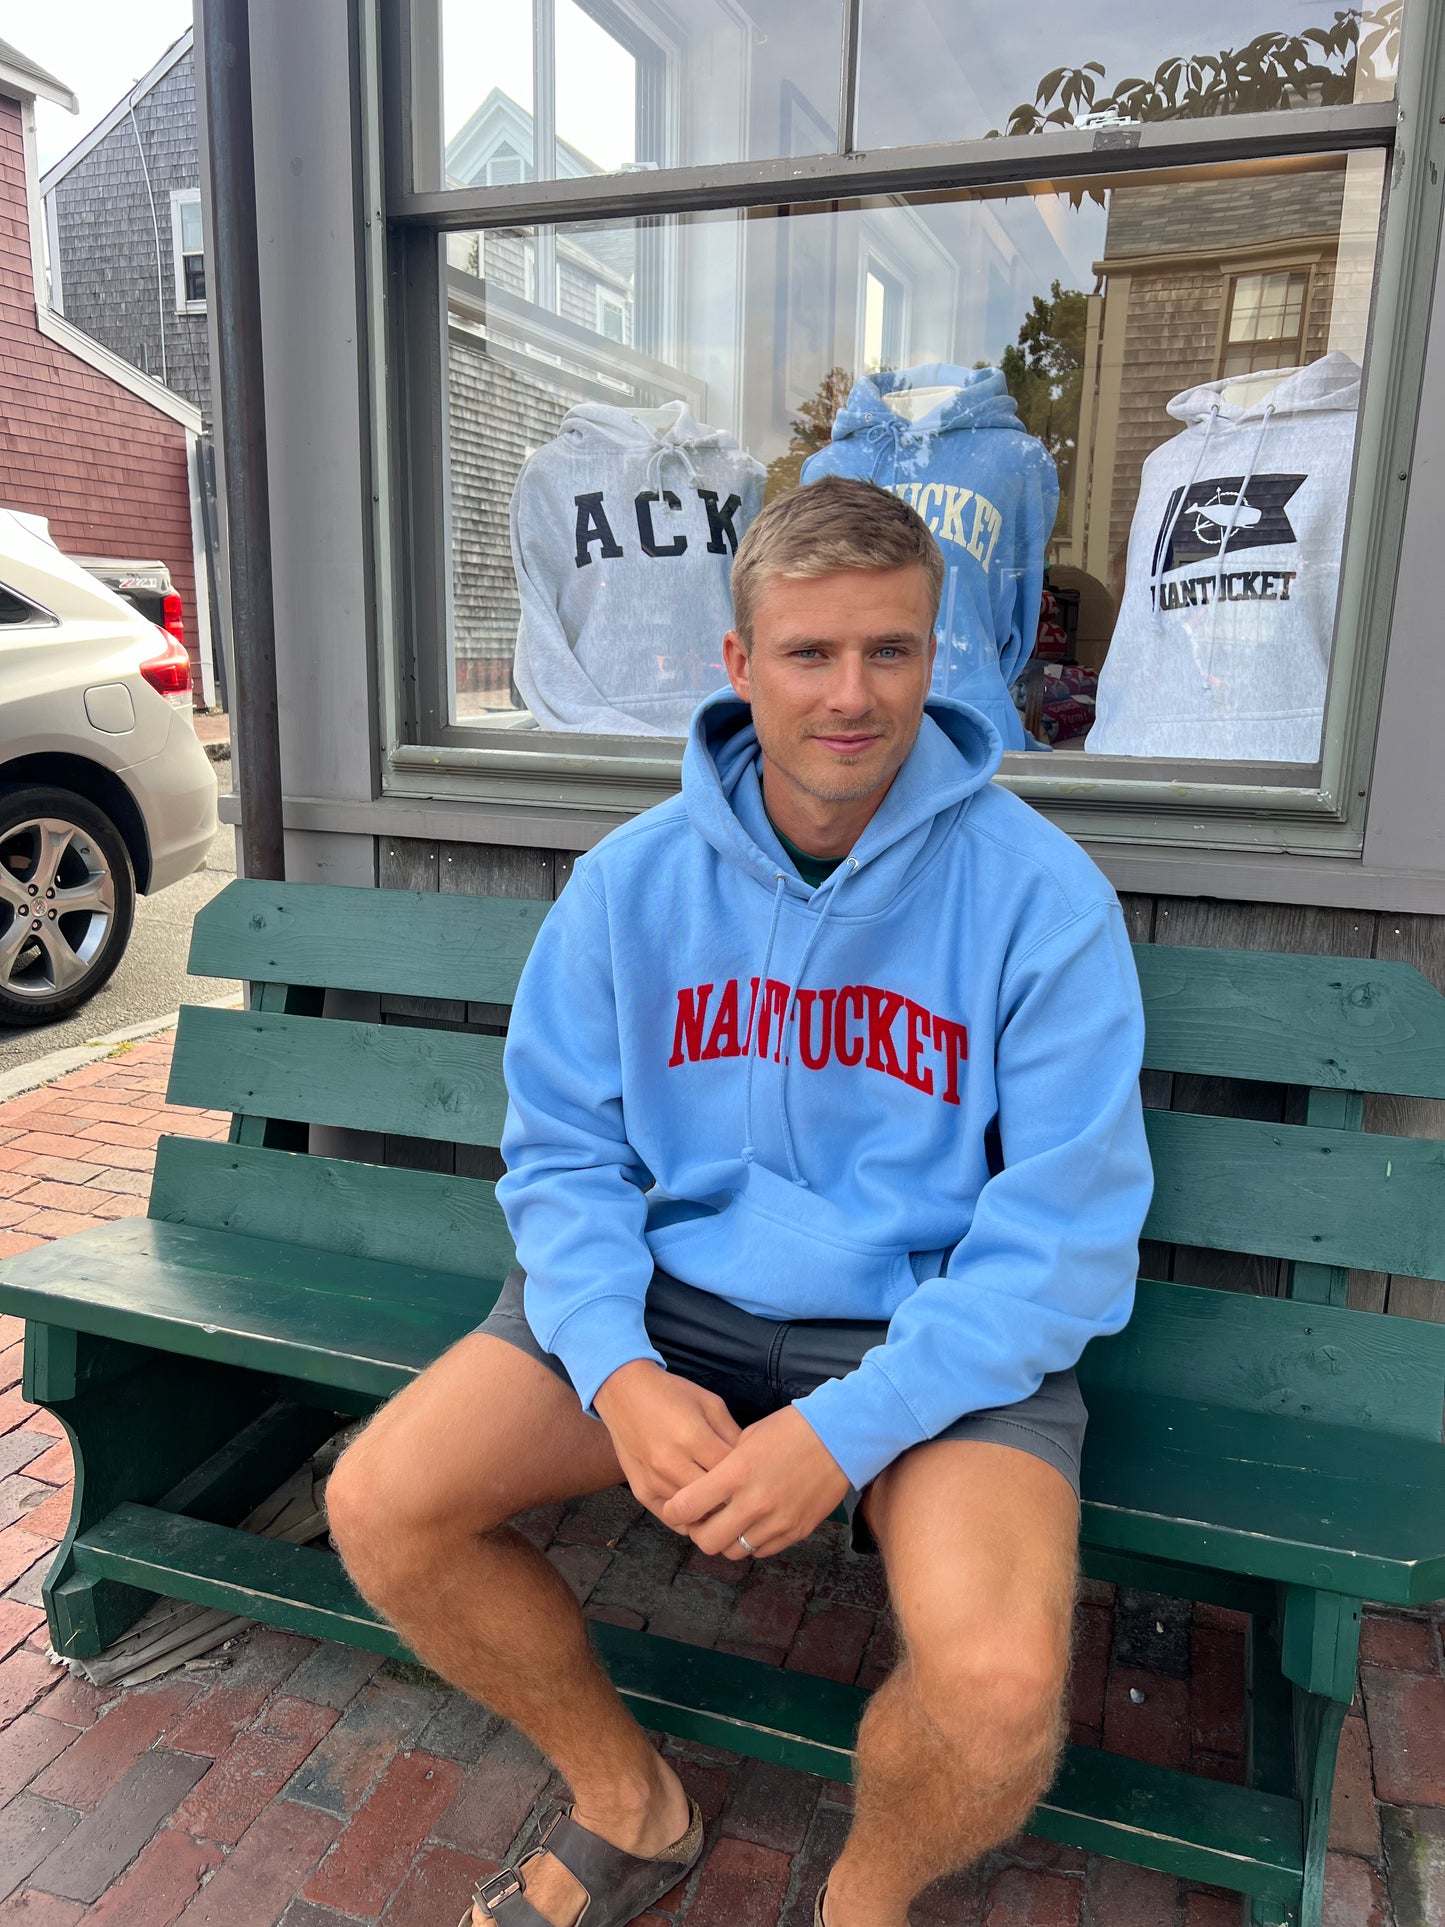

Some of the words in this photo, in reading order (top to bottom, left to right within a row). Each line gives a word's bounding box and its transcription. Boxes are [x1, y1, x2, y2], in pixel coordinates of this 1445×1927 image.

[574, 488, 742, 569] ACK
[882, 482, 1003, 574] CKET
[668, 976, 968, 1106] NANTUCKET
